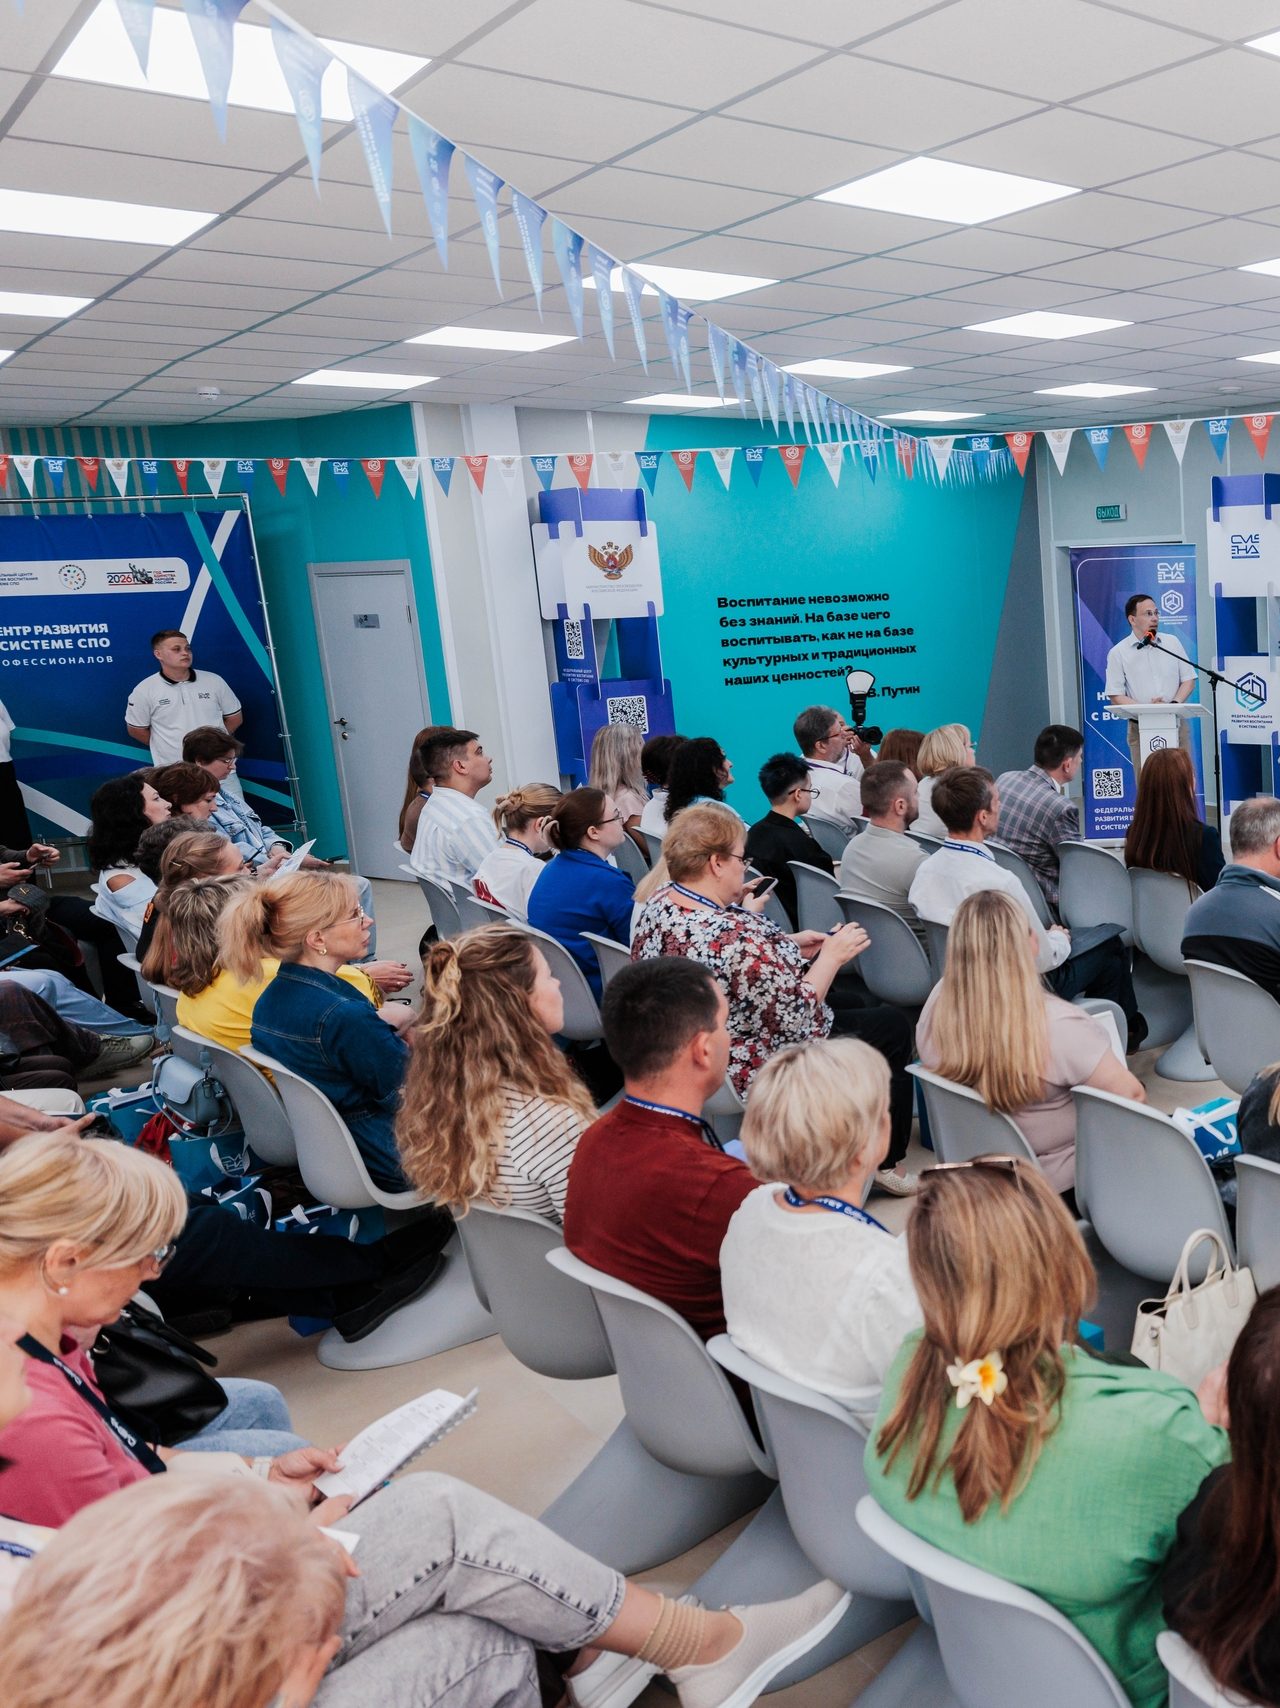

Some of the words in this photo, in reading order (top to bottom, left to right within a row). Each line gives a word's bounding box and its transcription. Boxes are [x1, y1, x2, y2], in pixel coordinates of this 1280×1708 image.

[717, 595, 806, 608] Воспитание
[808, 592, 890, 604] невозможно
[719, 615, 746, 628] без
[749, 613, 803, 626] знаний.
[805, 612, 824, 624] На
[826, 610, 859, 622] базе
[861, 610, 891, 620] чего
[33, 623, 108, 636] РАЗВИТИЯ
[721, 633, 820, 648] воспитывать,
[821, 631, 846, 641] как
[847, 629, 864, 639] не
[866, 628, 881, 638] на
[883, 626, 914, 637] базе
[0, 639, 73, 651] СИСТЕМЕ
[77, 637, 111, 648] СПО
[722, 652, 810, 669] культурных
[811, 652, 820, 660] и
[821, 644, 917, 663] традиционных
[724, 675, 770, 687] наших
[772, 665, 854, 684] ценностей?
[881, 684, 920, 698] Путин
